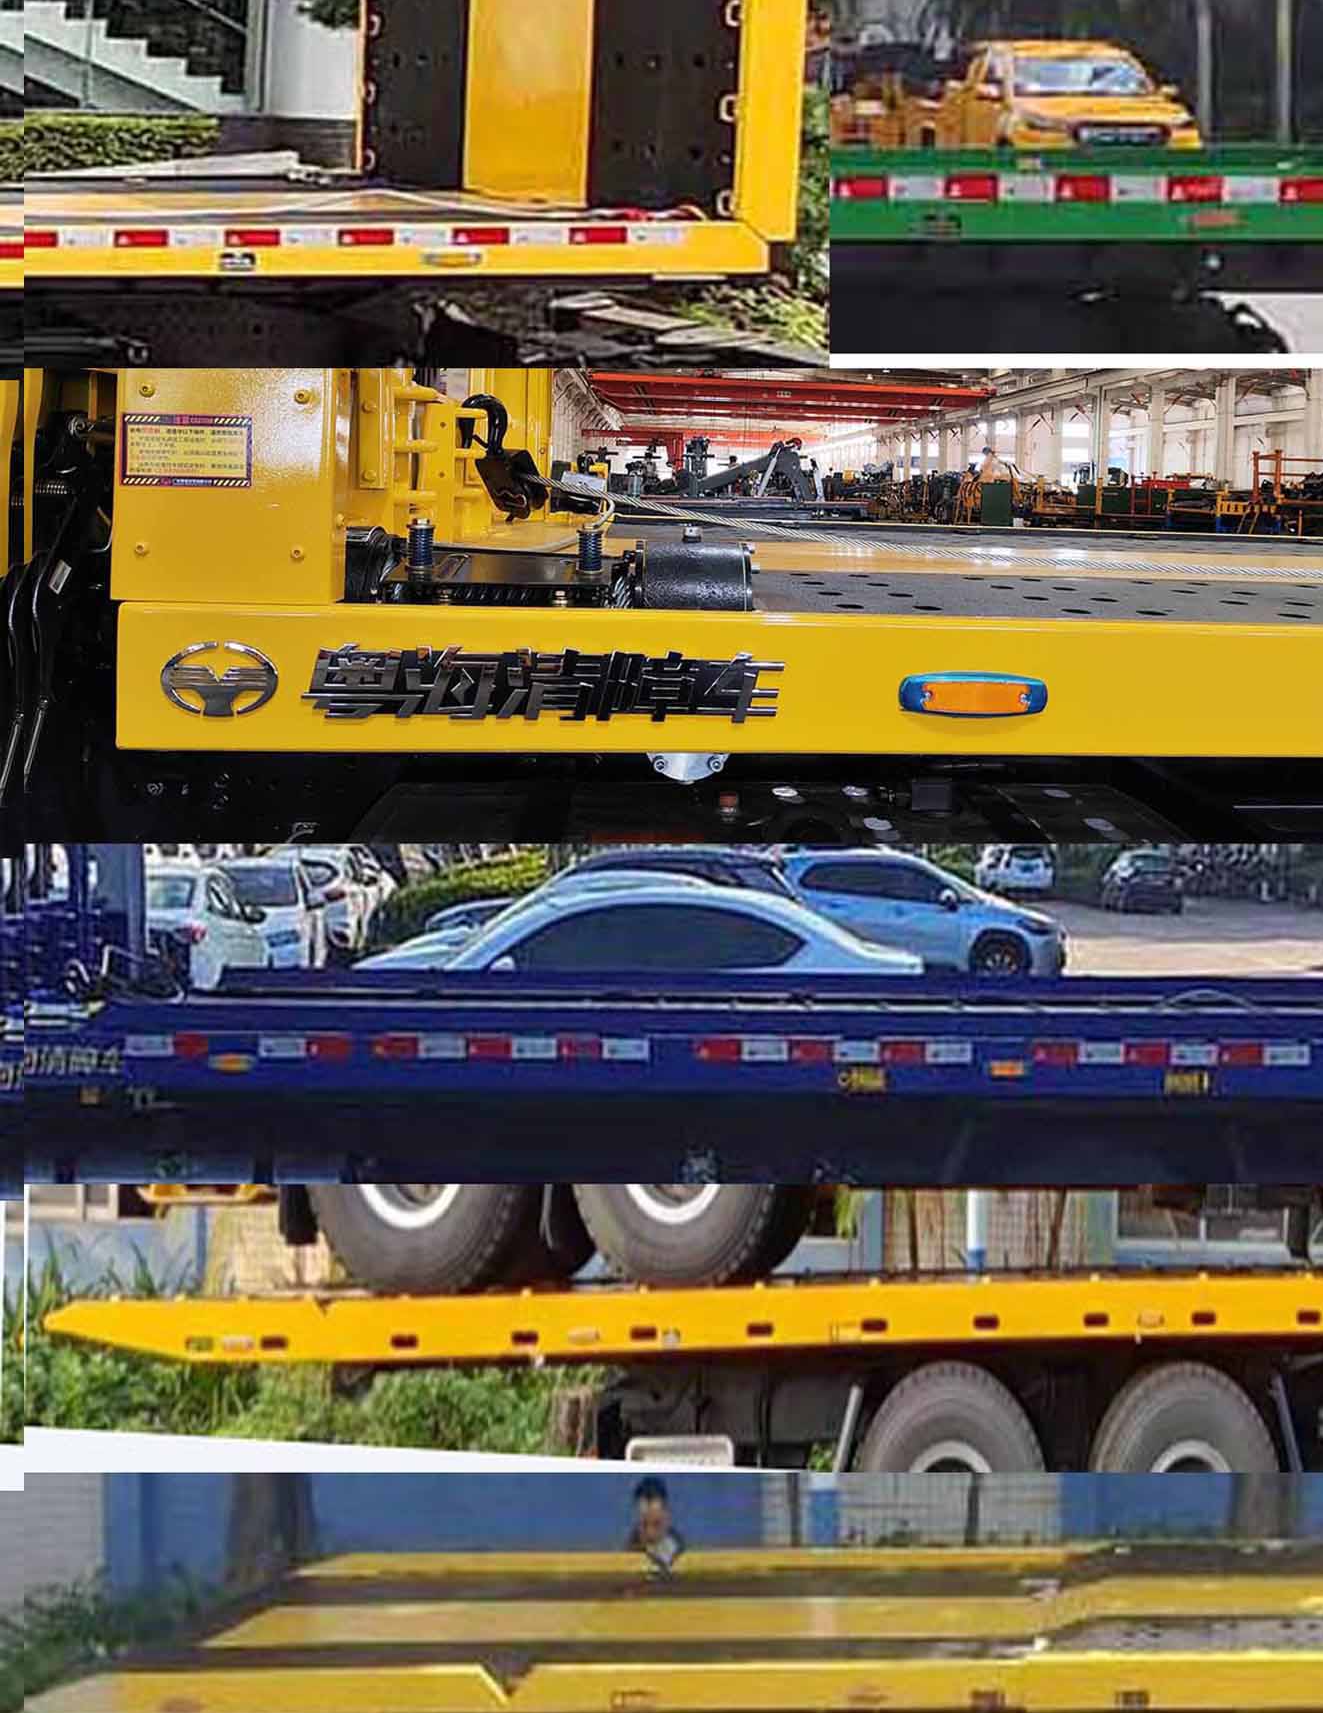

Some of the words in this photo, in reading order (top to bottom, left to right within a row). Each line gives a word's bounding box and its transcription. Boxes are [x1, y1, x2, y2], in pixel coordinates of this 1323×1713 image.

[302, 642, 785, 724] 粤海清障车
